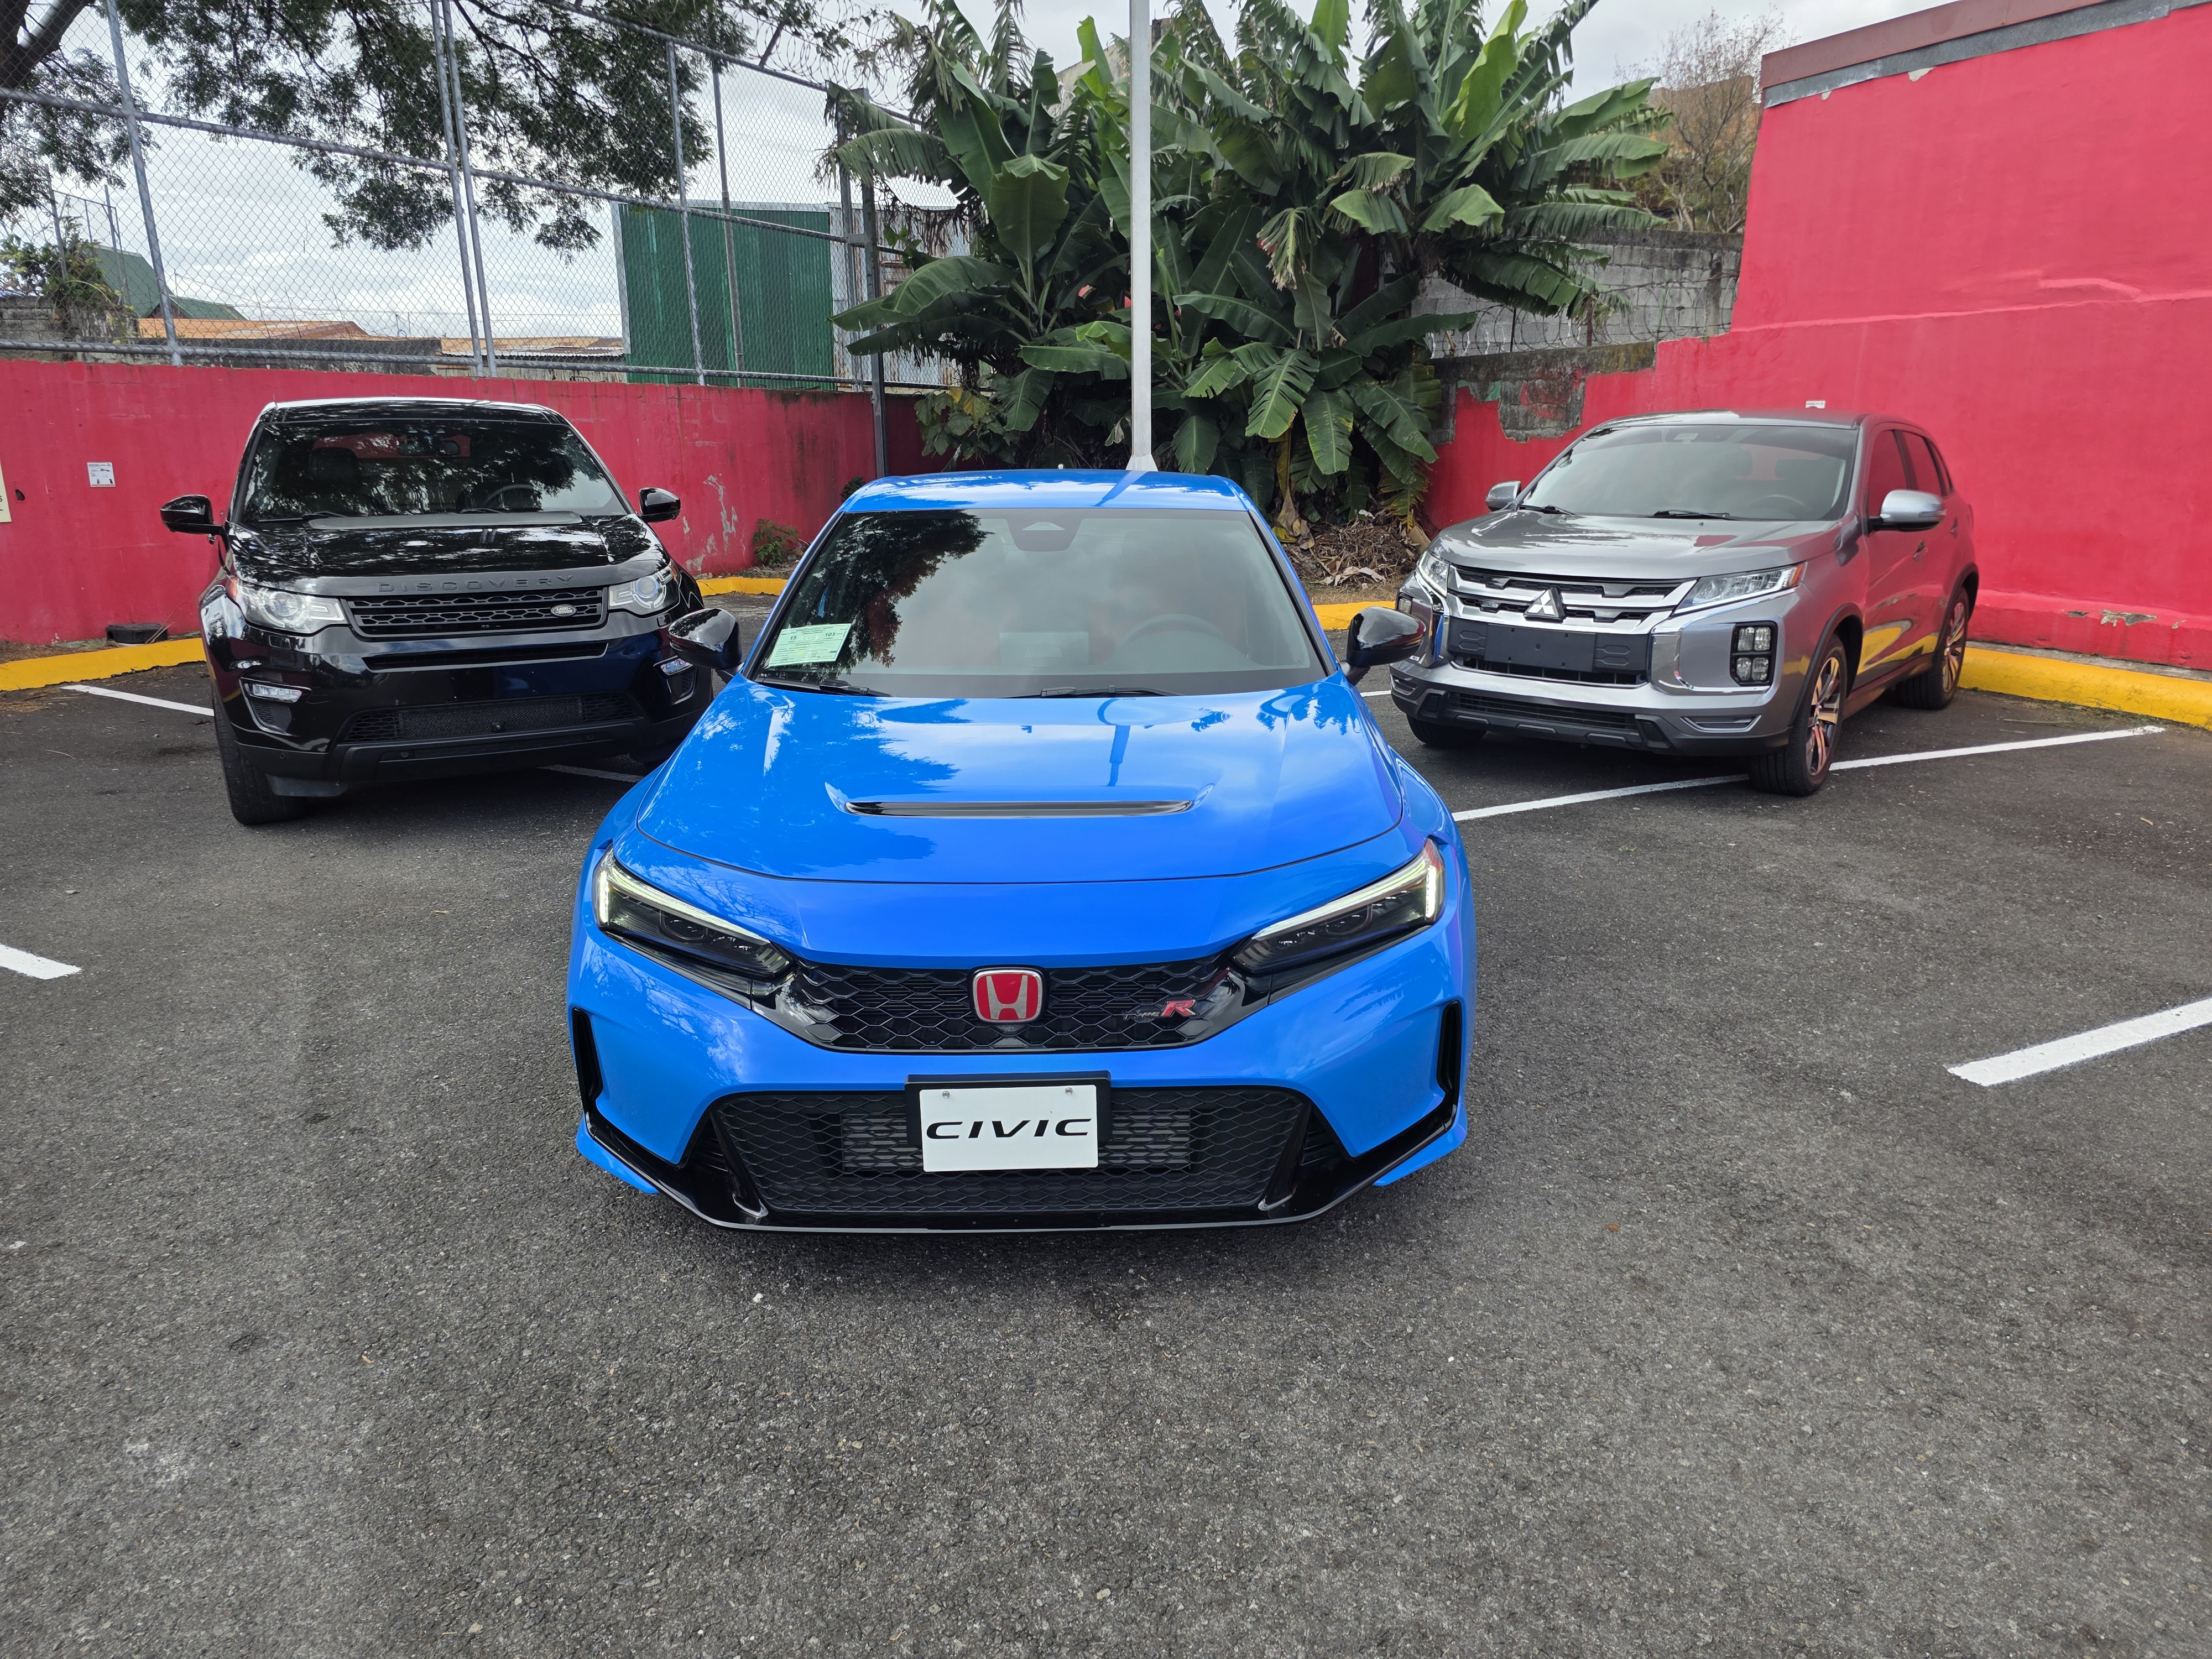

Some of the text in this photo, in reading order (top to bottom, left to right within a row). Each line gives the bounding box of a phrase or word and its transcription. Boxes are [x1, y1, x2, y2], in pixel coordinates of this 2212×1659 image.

[378, 575, 573, 592] DISCOVERY
[1161, 999, 1196, 1017] R
[926, 1118, 1092, 1139] CIVIC
